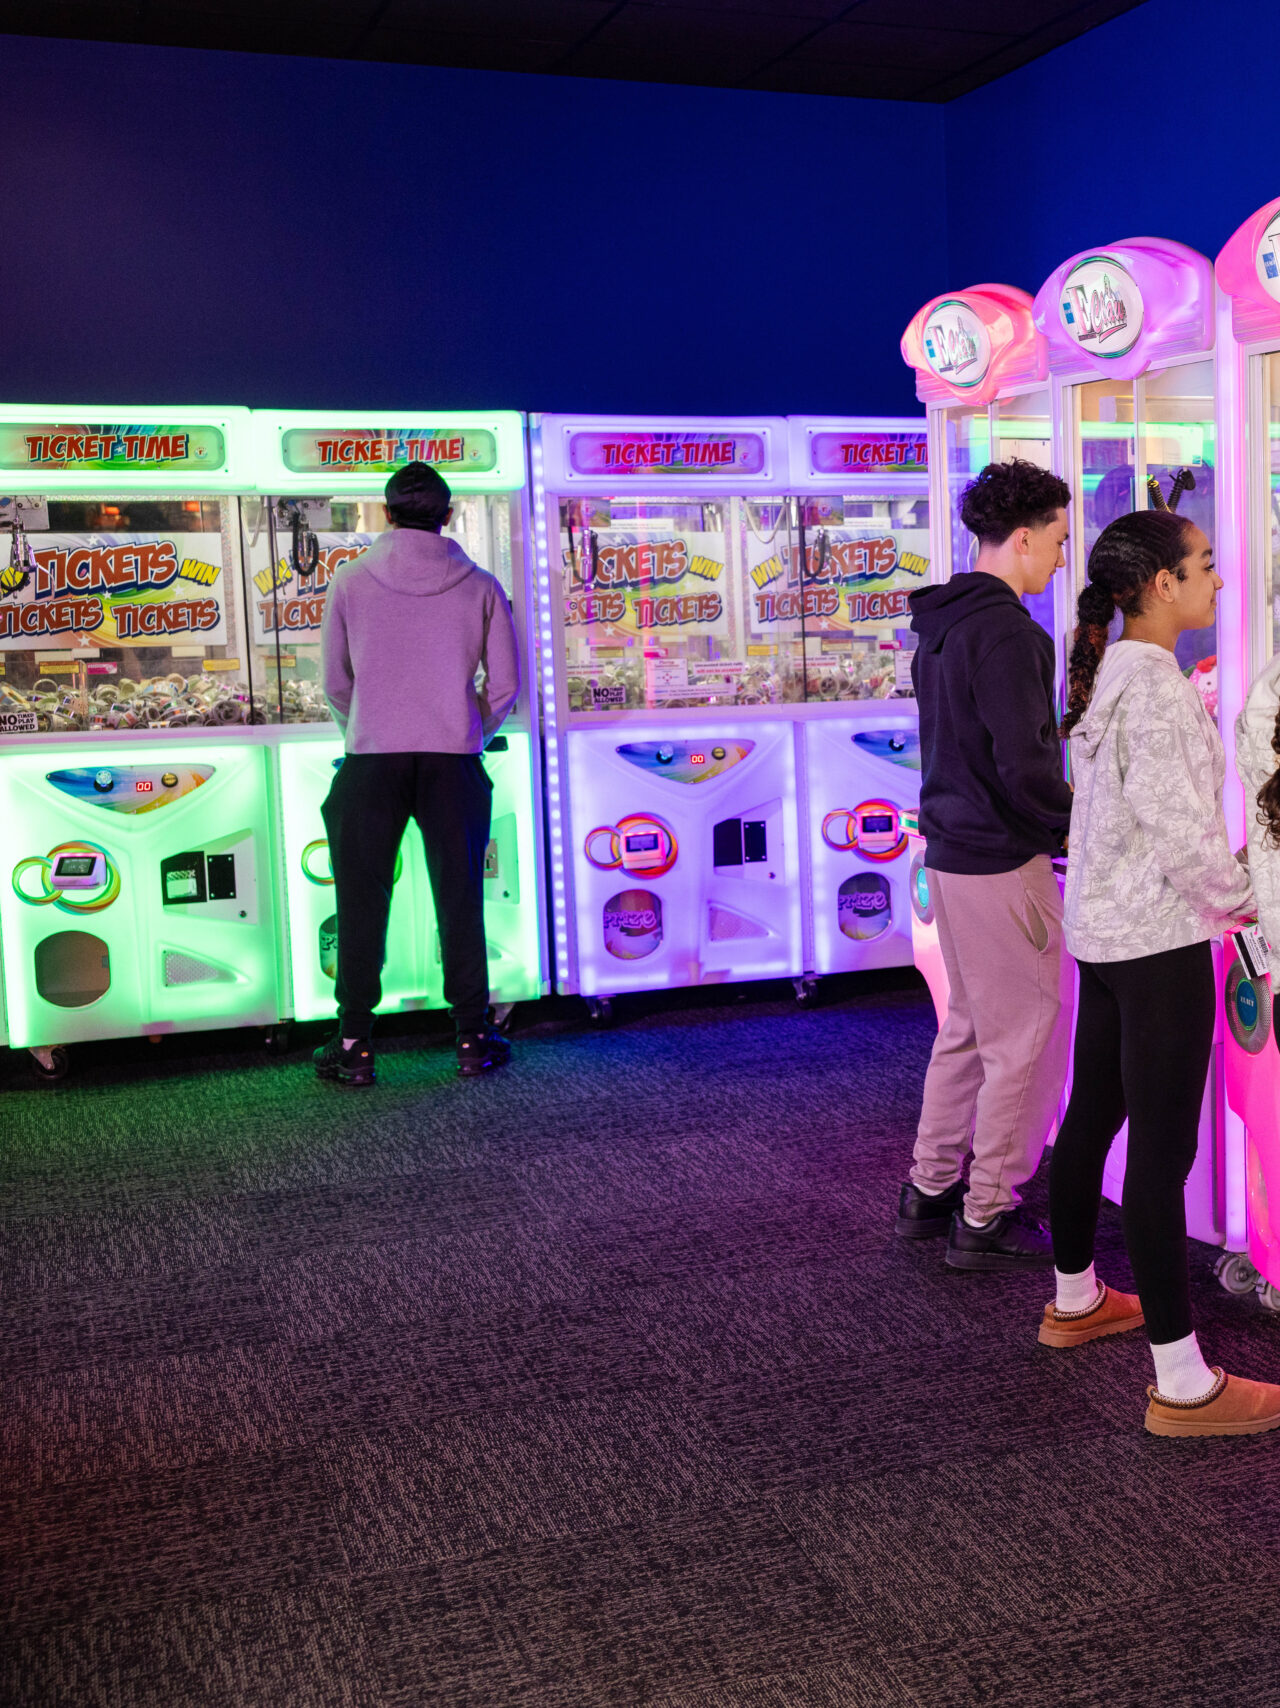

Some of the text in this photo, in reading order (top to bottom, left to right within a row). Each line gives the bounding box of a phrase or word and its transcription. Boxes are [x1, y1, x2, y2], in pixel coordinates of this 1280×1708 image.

[24, 433, 189, 462] TICKET TIME
[315, 437, 464, 466] TICKET TIME
[602, 440, 735, 467] TICKET TIME
[841, 442, 909, 466] TICKET
[34, 540, 178, 600] TICKETS
[179, 558, 221, 587] WIN
[688, 555, 724, 581] WIN
[750, 554, 784, 590] WIN
[898, 551, 931, 577] WIN
[0, 598, 220, 638] TICKETS TICKETS
[257, 596, 326, 634] TICKE
[632, 591, 723, 629] TICKETS
[753, 586, 912, 624] TICKETS TICKET
[593, 687, 609, 698] NO
[0, 714, 17, 726] NO
[0, 724, 35, 732] ALLOWED
[691, 755, 704, 763] 00
[136, 782, 151, 791] 00
